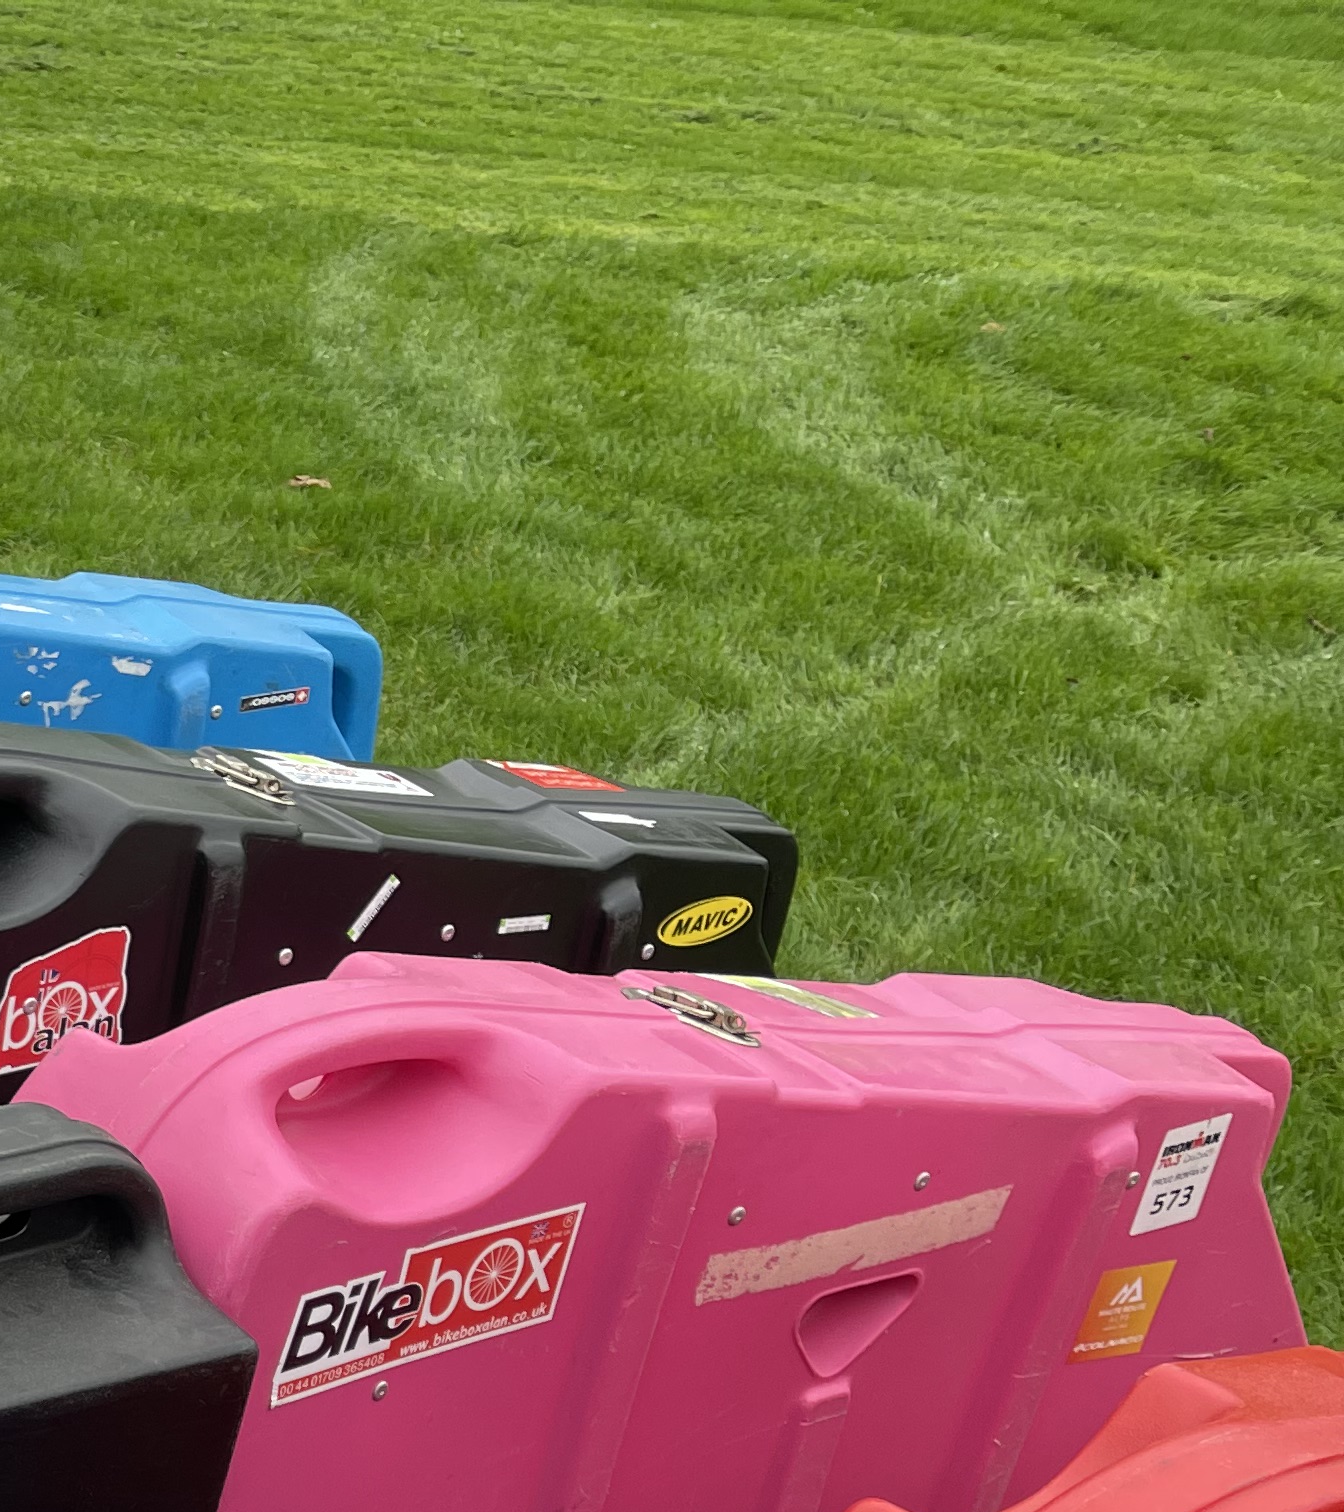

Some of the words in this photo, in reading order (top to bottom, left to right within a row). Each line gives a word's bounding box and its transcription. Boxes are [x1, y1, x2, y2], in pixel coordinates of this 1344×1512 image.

[672, 908, 738, 937] MAVIC
[1149, 1185, 1195, 1215] 573
[399, 1302, 548, 1357] www.bikeboxalan.co.uk
[280, 1383, 294, 1397] 00
[296, 1378, 310, 1392] 44
[311, 1367, 342, 1387] 01709
[343, 1353, 385, 1377] 365408
